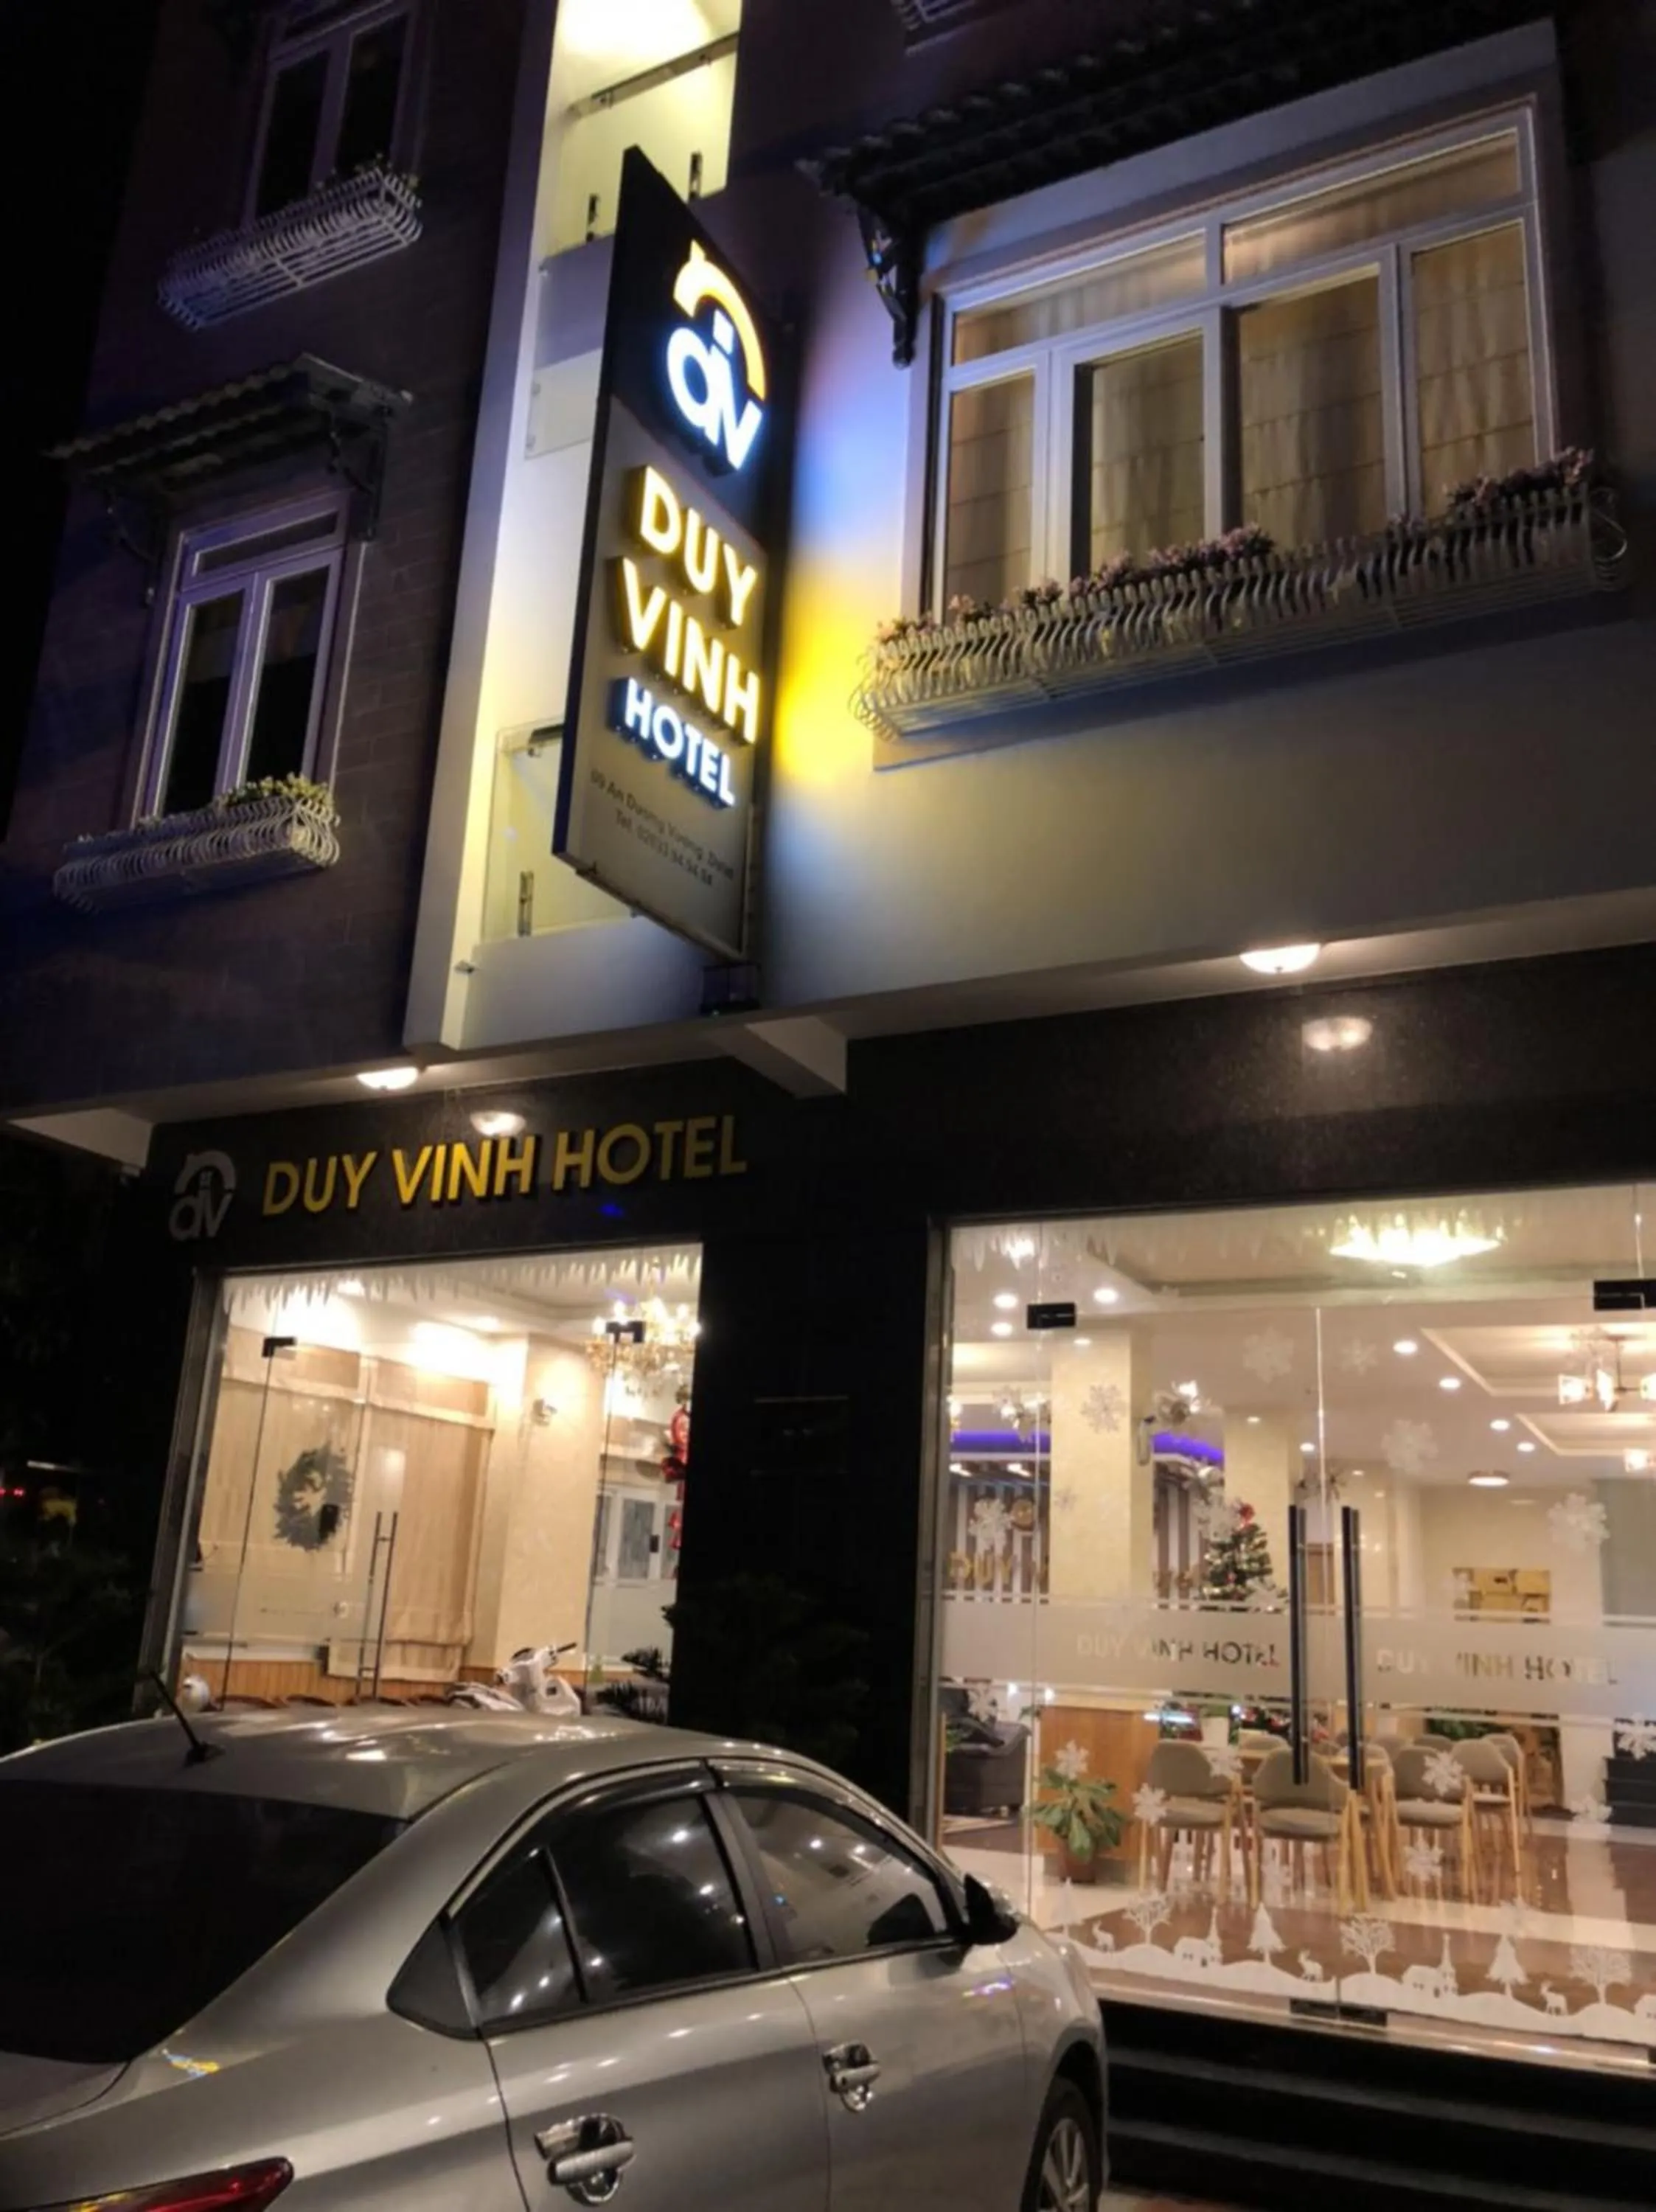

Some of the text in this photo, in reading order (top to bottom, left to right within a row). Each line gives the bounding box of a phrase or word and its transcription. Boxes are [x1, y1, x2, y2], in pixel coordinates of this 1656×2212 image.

[639, 465, 758, 627] DUY
[622, 557, 759, 745] VINH
[625, 676, 736, 806] HOTEL
[262, 1115, 747, 1217] DUY VINH HOTEL
[1076, 1634, 1127, 1658] DUY
[1203, 1640, 1280, 1668] HOTEL
